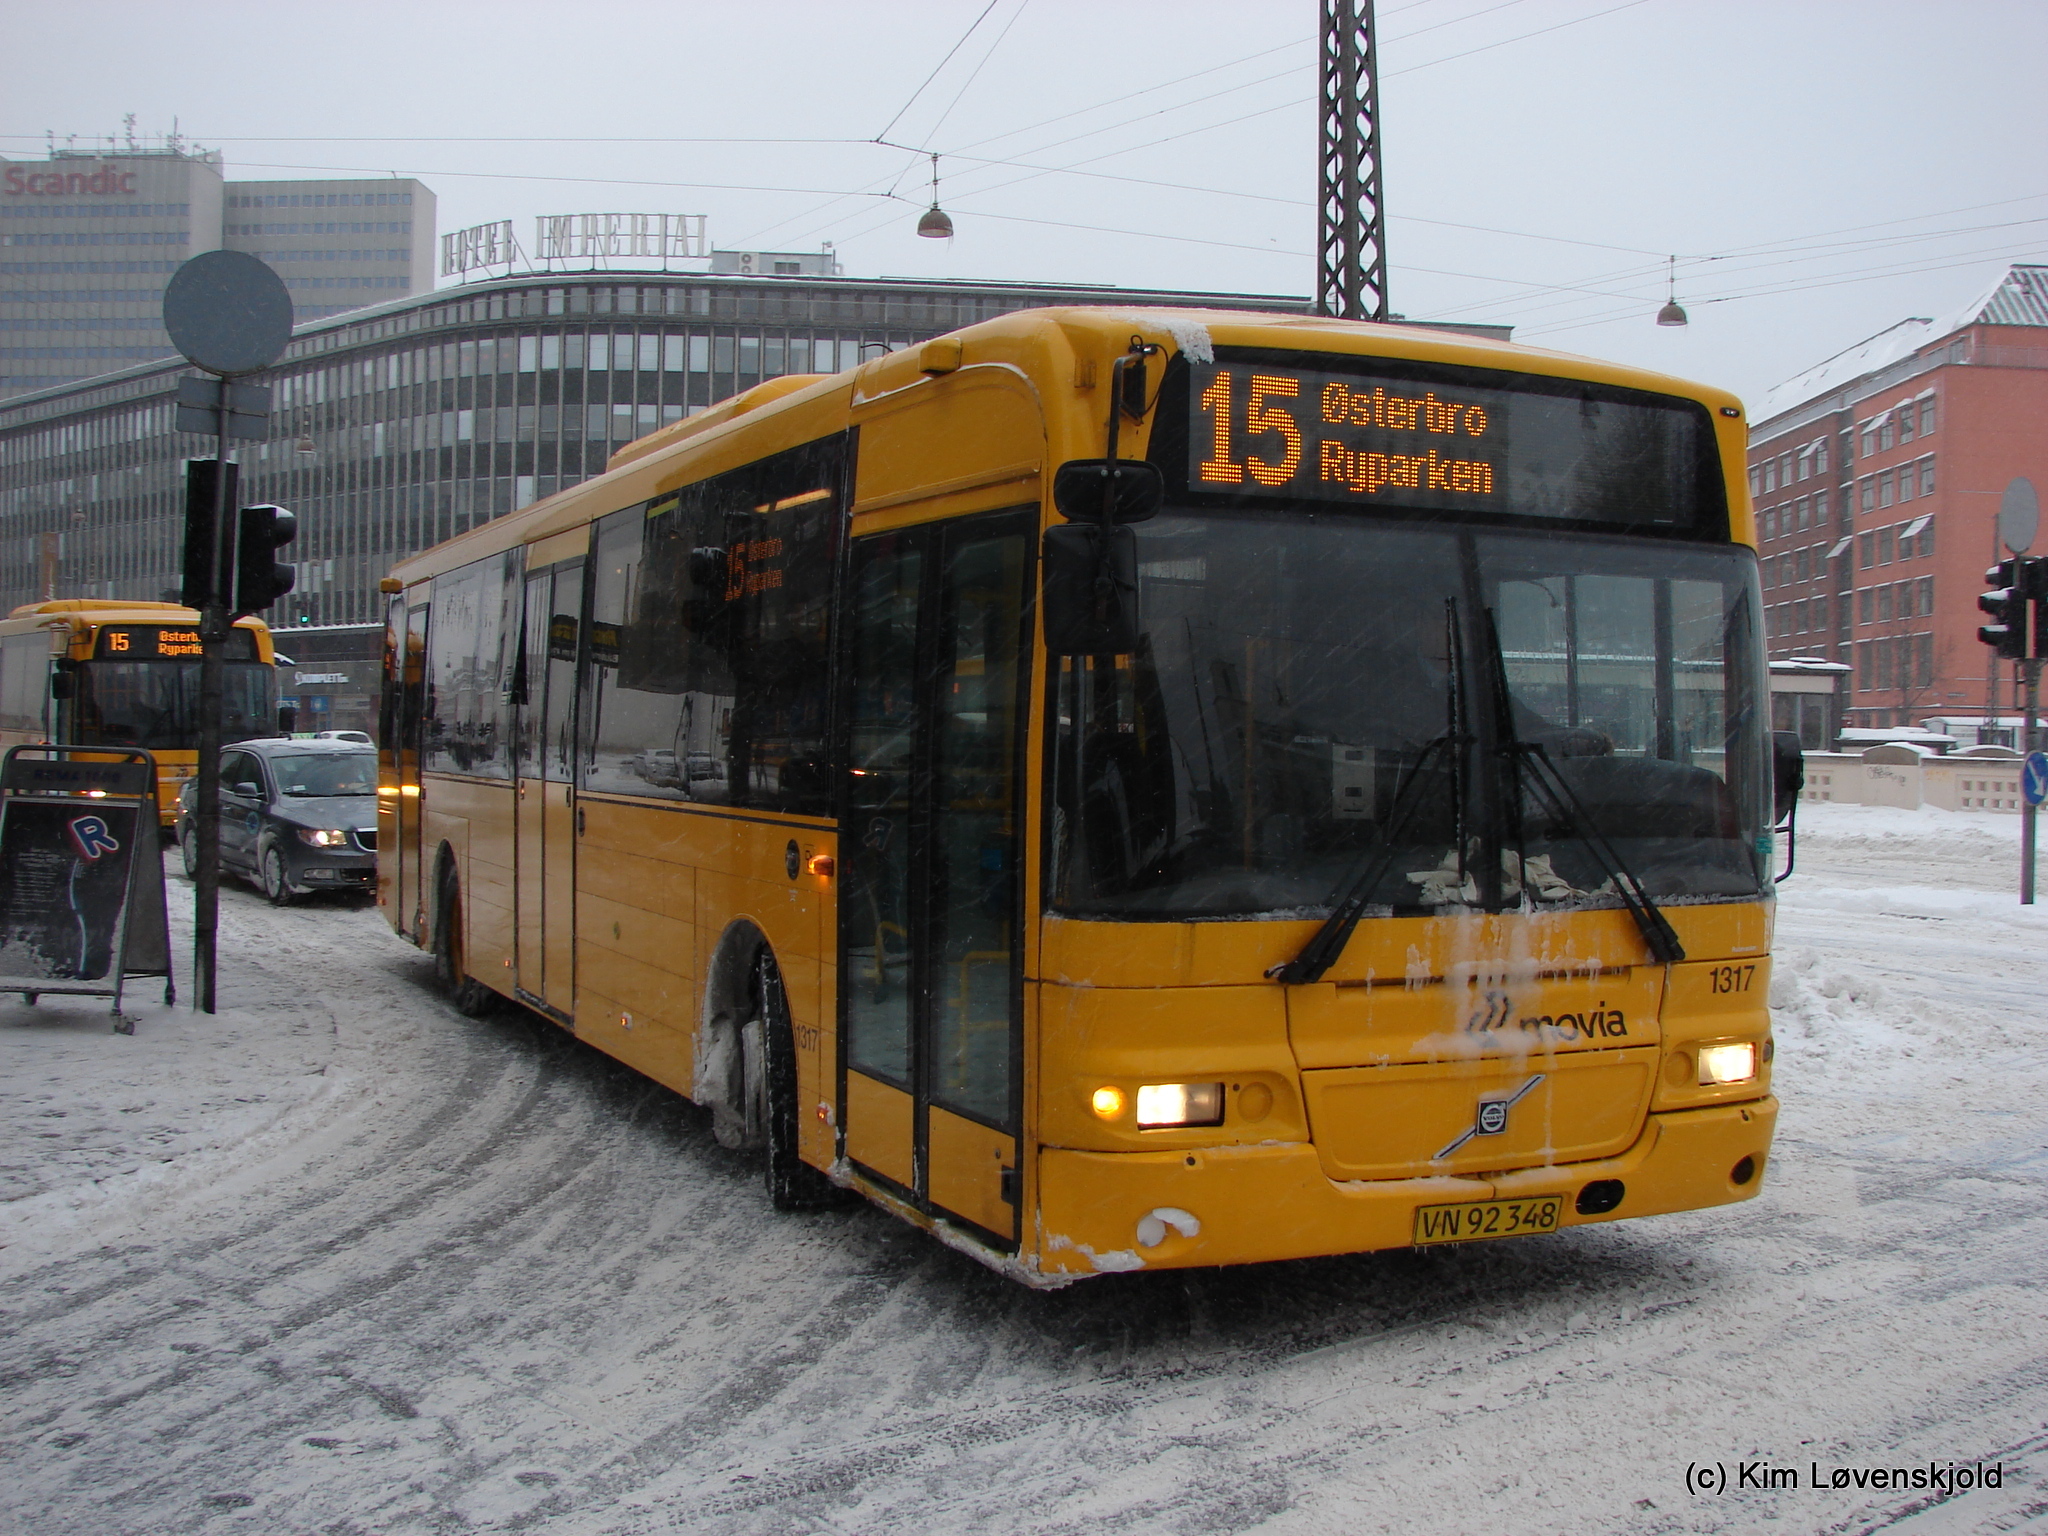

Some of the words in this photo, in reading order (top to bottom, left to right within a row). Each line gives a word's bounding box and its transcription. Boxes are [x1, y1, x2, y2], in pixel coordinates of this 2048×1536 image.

[4, 164, 137, 195] Scandic
[440, 219, 517, 278] HOTEL
[534, 212, 712, 260] IMPERIAL
[1200, 370, 1302, 487] 15
[1321, 381, 1488, 437] Østerbro
[1320, 439, 1492, 494] Ryparken
[109, 632, 130, 651] 15
[157, 630, 202, 642] Østerb
[70, 815, 119, 859] R
[1709, 965, 1756, 995] 1317
[796, 1023, 819, 1053] 1317
[1519, 1000, 1628, 1041] movia
